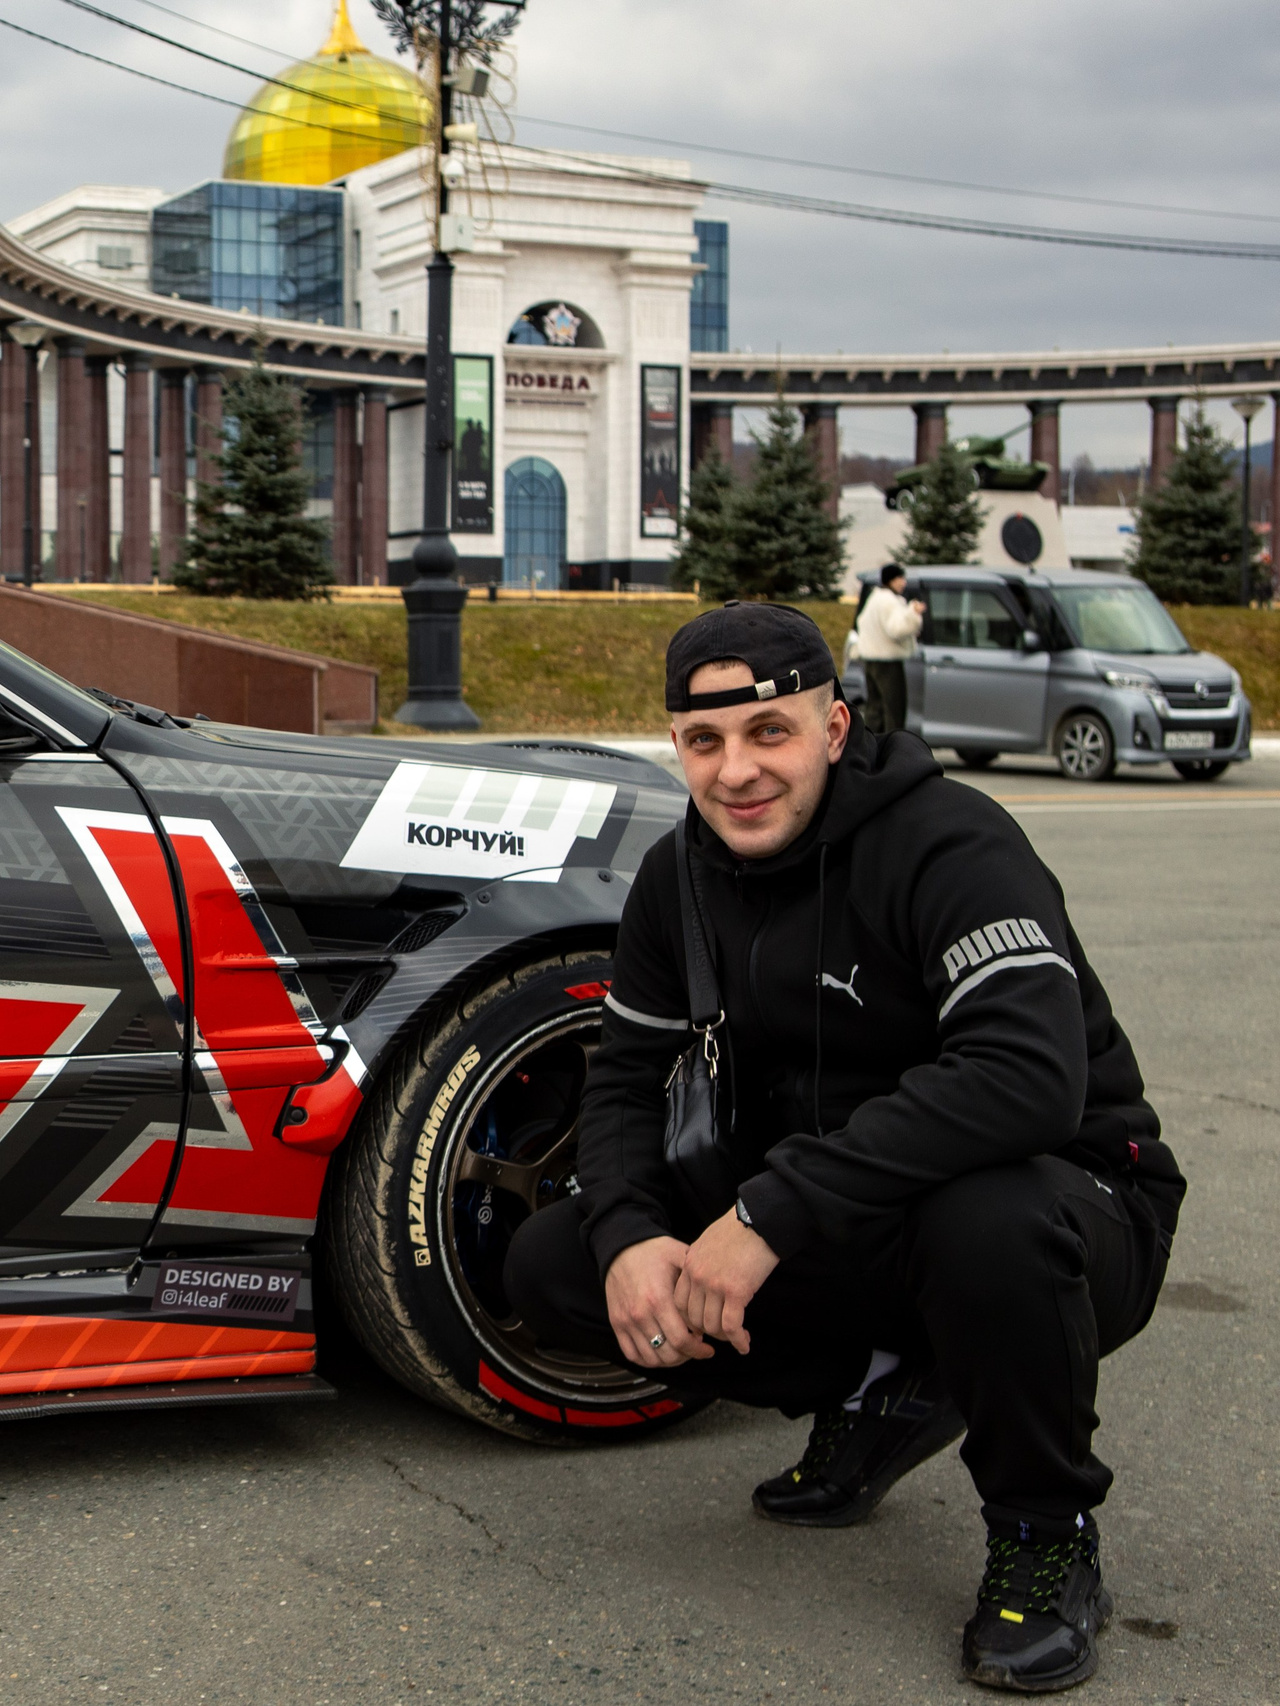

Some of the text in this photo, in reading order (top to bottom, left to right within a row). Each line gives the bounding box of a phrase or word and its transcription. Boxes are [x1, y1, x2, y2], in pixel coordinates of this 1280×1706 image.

[506, 372, 591, 390] ПОБЕДА
[407, 822, 525, 857] КОРЧУЙ!
[942, 918, 1052, 983] PUMA
[164, 1268, 294, 1292] DESIGNED BY
[177, 1290, 228, 1309] i4leaf
